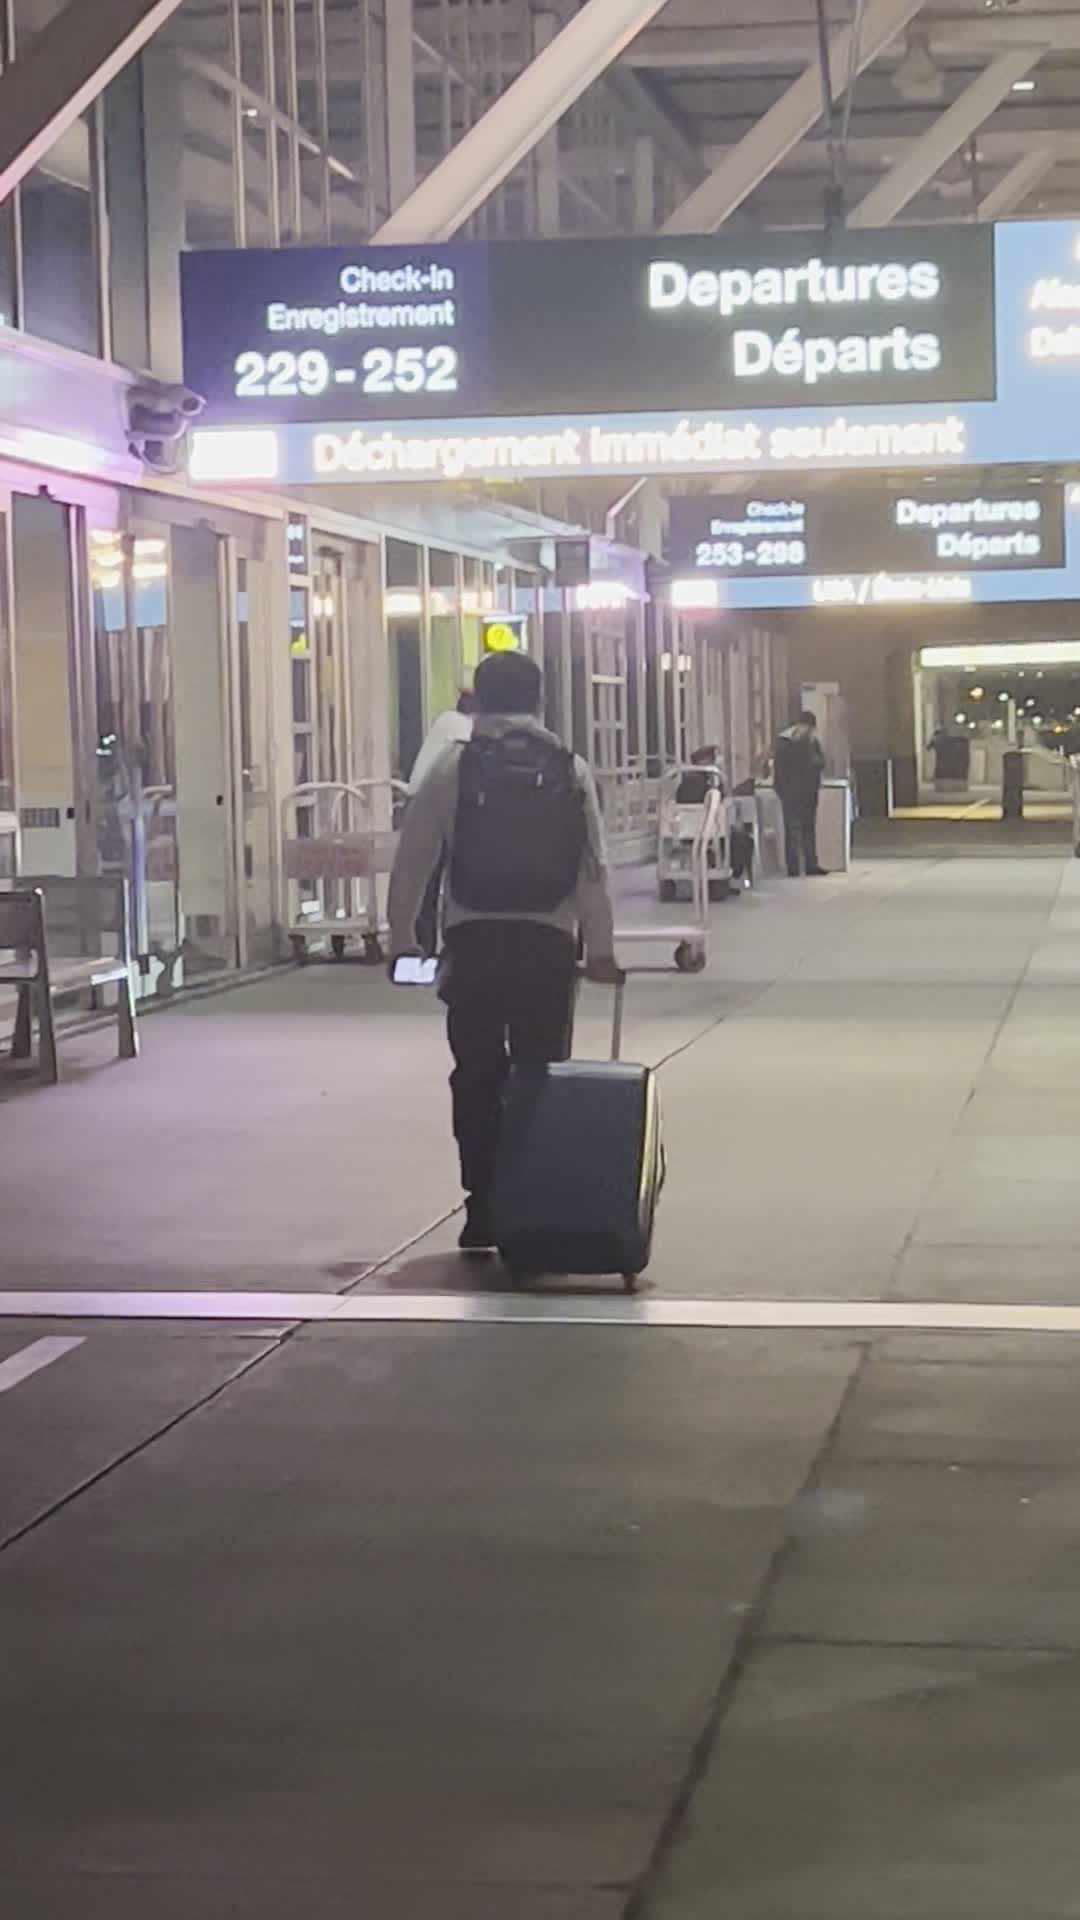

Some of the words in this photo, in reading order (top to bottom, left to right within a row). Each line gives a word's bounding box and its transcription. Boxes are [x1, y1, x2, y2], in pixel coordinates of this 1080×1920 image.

[340, 264, 454, 294] Check-in
[648, 259, 940, 314] Departures
[267, 300, 455, 334] Enregistrement
[732, 327, 941, 383] Départs
[896, 498, 1041, 527] Departures
[937, 532, 1041, 560] Départs
